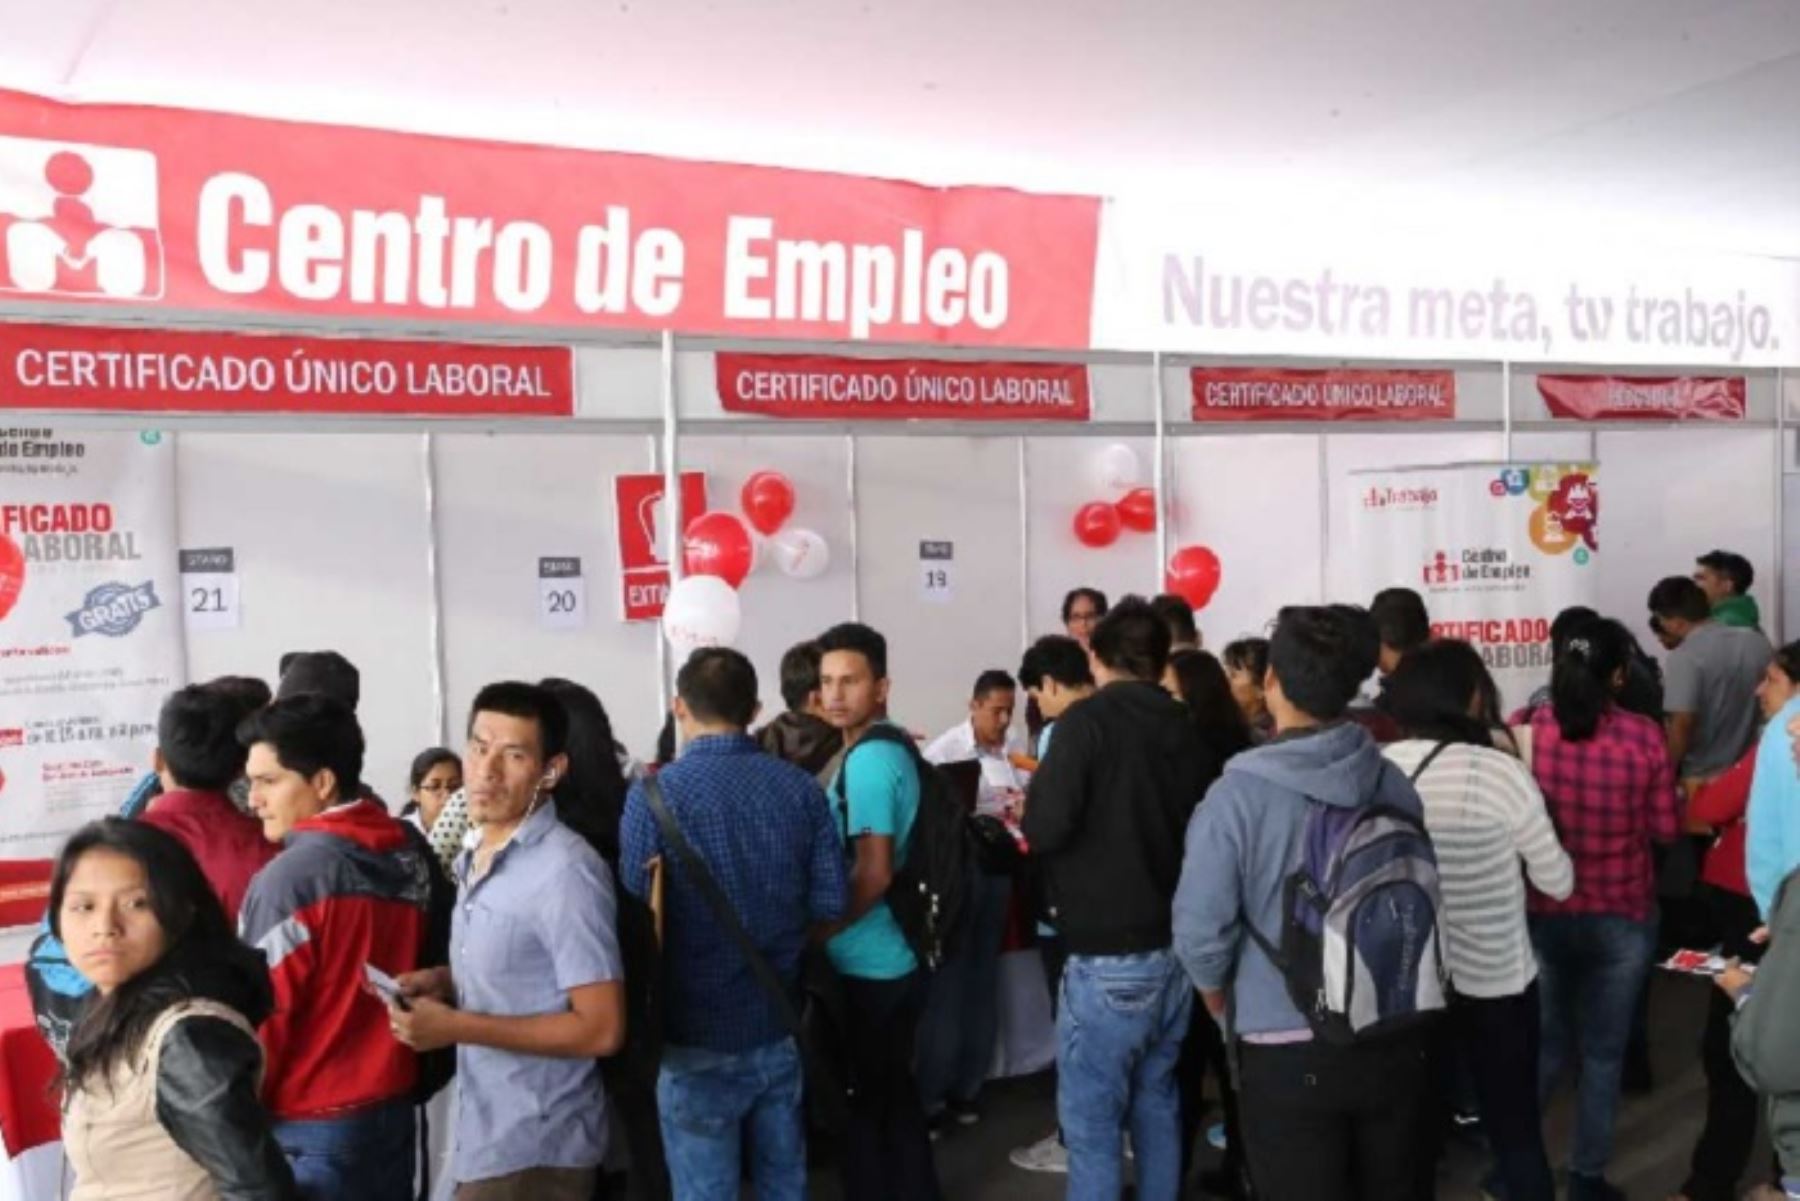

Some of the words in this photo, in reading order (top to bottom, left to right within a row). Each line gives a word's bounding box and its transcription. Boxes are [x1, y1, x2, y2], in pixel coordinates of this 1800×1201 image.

[198, 172, 553, 312] Centro
[575, 206, 684, 316] de
[724, 215, 1009, 338] Empleo
[1162, 253, 1391, 336] Nuestra
[1407, 279, 1553, 352] meta,
[1625, 285, 1780, 361] trabajo.
[15, 347, 275, 392] CERTIFICADO
[285, 350, 396, 394] ÚNICO
[405, 362, 551, 397] LABORAL
[736, 370, 896, 402] CERTIFICADO
[905, 367, 976, 404] ÚNICO
[980, 376, 1074, 407] LABORAL
[1205, 382, 1317, 407] CERTIFICADO
[1377, 383, 1445, 407] LABORAL
[22, 441, 85, 459] Empleo
[25, 532, 141, 562] ABORAL
[191, 587, 228, 612] 21
[548, 590, 576, 613] 20
[1428, 619, 1548, 643] RTIFICADO
